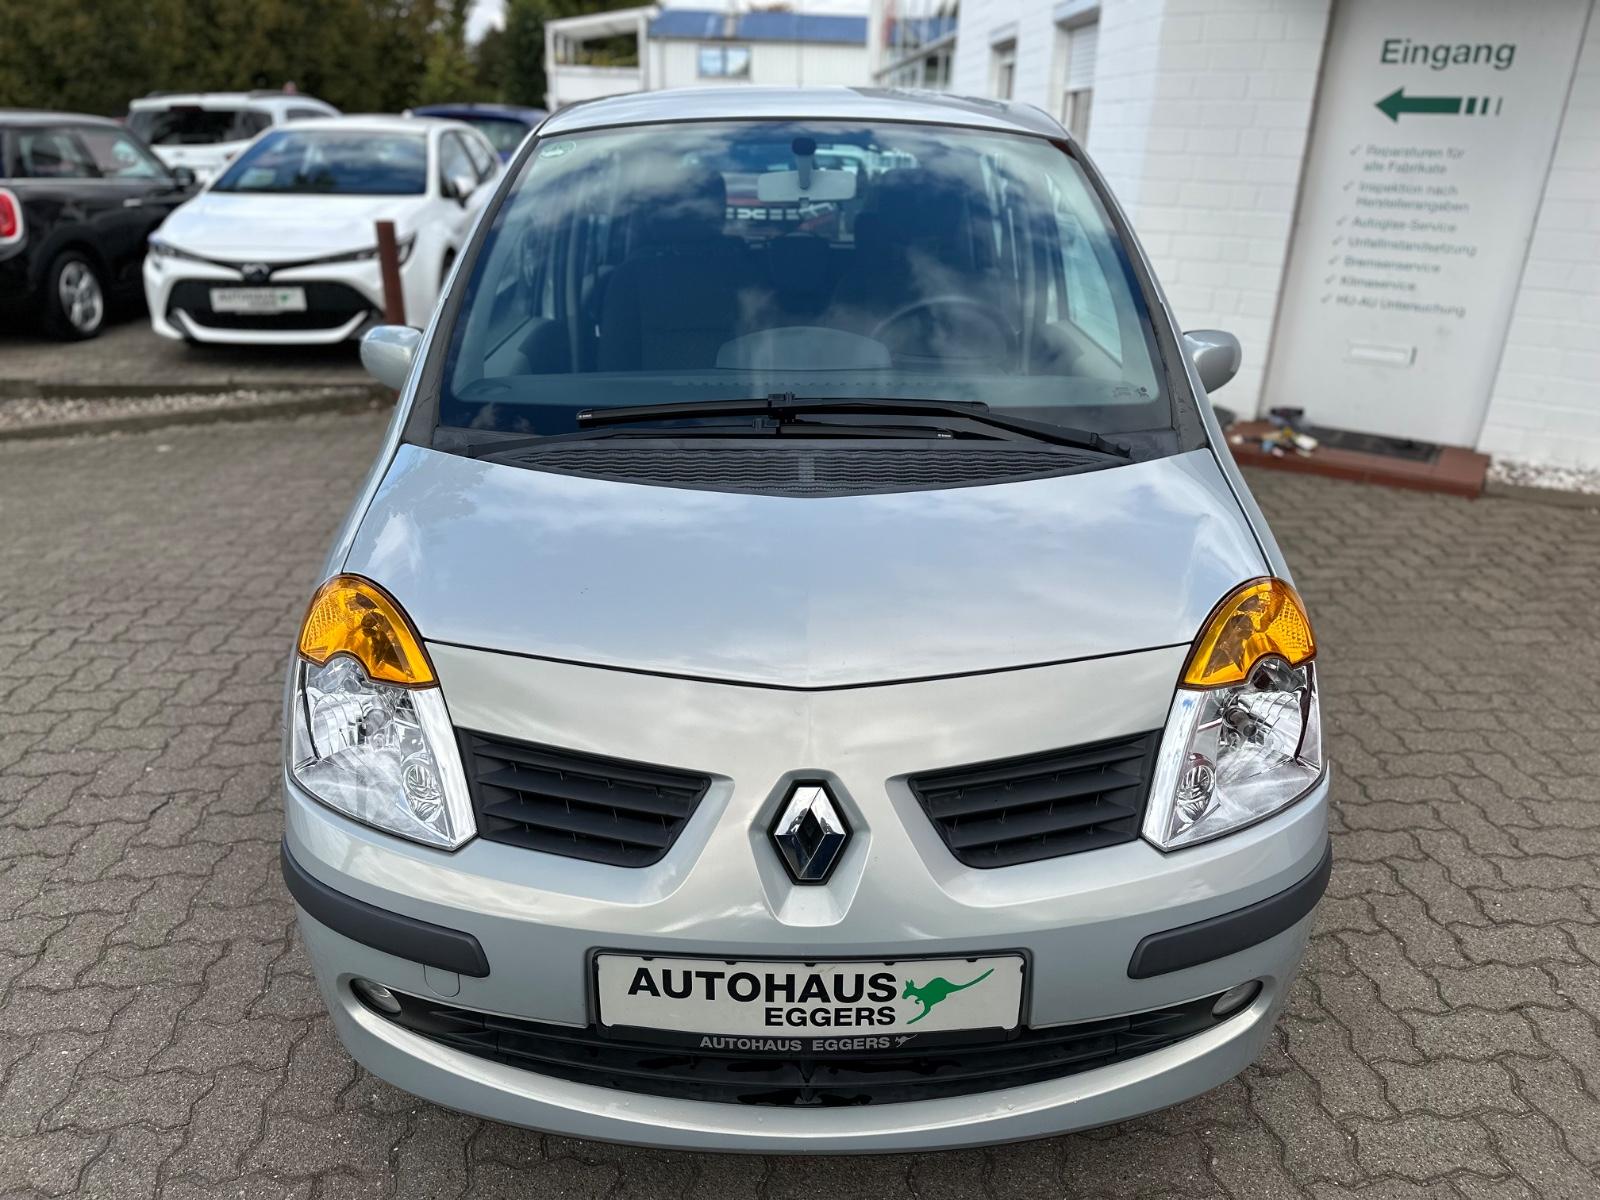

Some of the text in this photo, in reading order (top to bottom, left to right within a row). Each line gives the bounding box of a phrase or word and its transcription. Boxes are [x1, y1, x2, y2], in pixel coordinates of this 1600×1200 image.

[1380, 39, 1516, 71] Eingang
[628, 967, 898, 1003] AUTOHAUS
[764, 1007, 896, 1027] EGGERS
[699, 1036, 890, 1051] AUTOHAUS EGGERS
